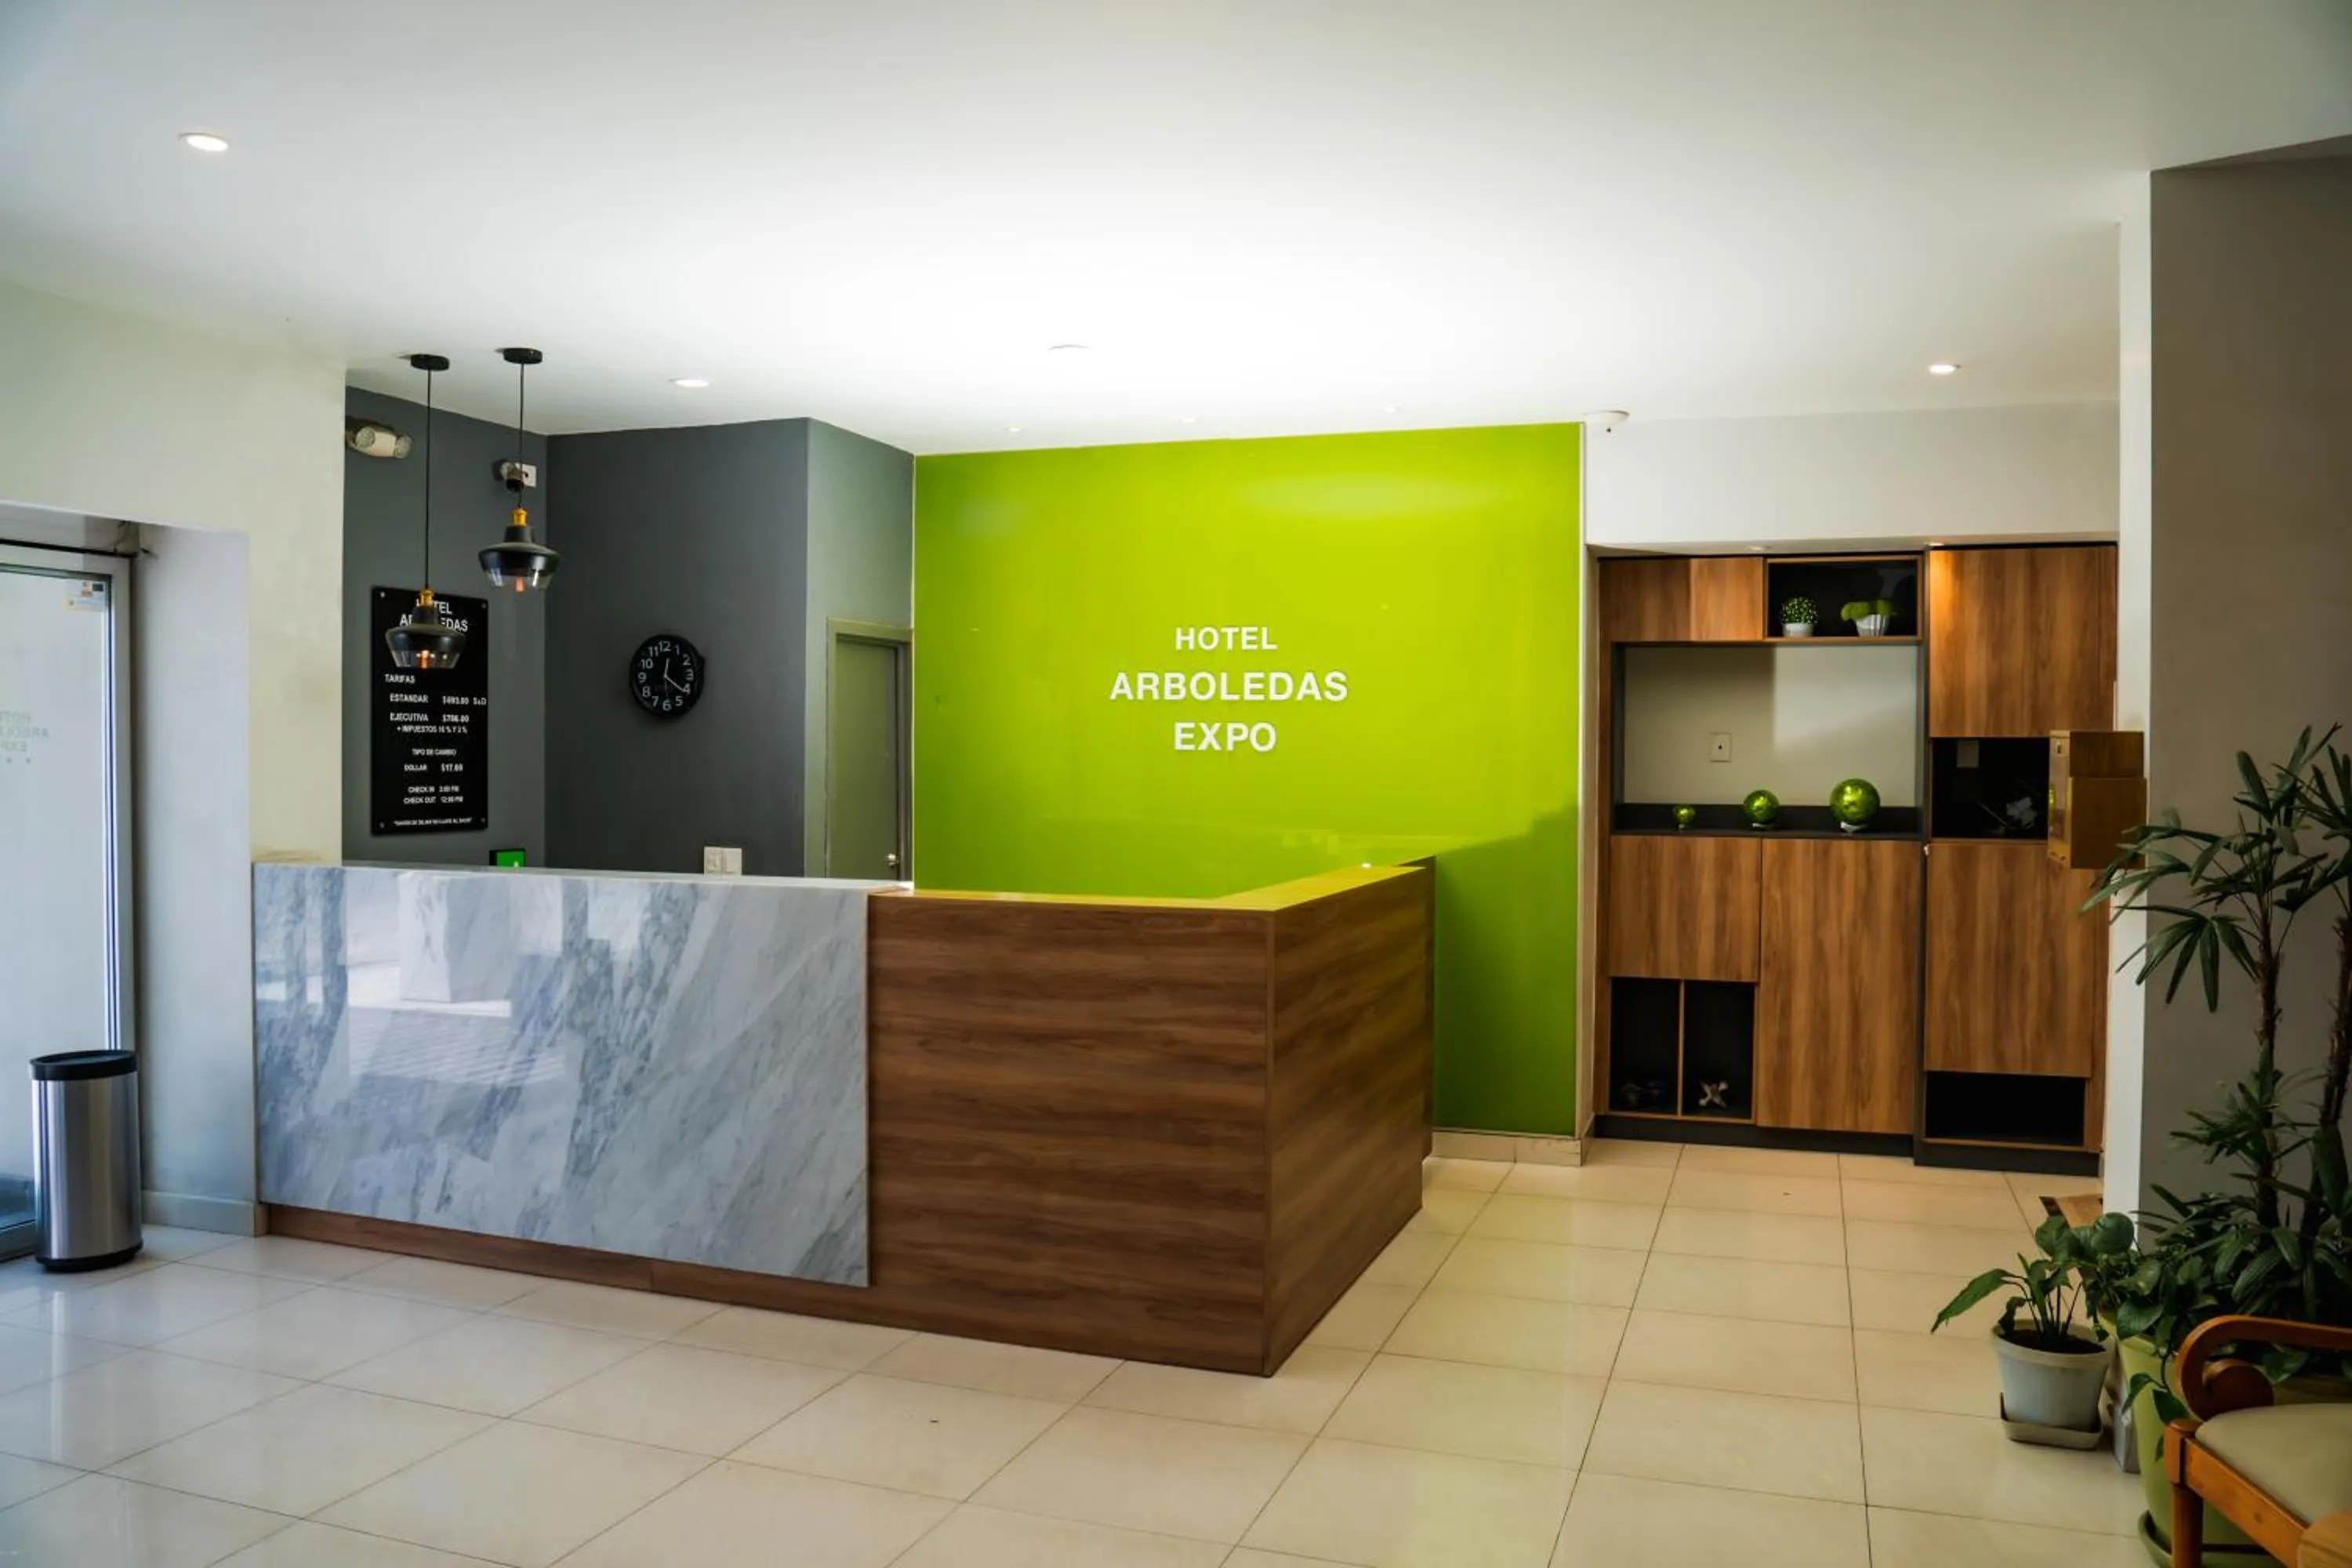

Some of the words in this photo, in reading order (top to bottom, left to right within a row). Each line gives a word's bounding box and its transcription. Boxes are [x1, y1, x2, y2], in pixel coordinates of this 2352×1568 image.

[1176, 627, 1277, 650] HOTEL
[648, 646, 658, 657] 11
[659, 641, 671, 652] 12
[674, 644, 680, 655] 1
[641, 658, 653, 669] 10
[683, 654, 690, 665] 2
[638, 672, 646, 684] 9
[686, 669, 693, 681] 3
[1110, 671, 1347, 701] ARBOLEDAS
[642, 686, 651, 698] 8
[652, 696, 659, 706] 7
[662, 699, 671, 710] 6
[676, 696, 683, 706] 5
[1174, 722, 1276, 752] EXPO
